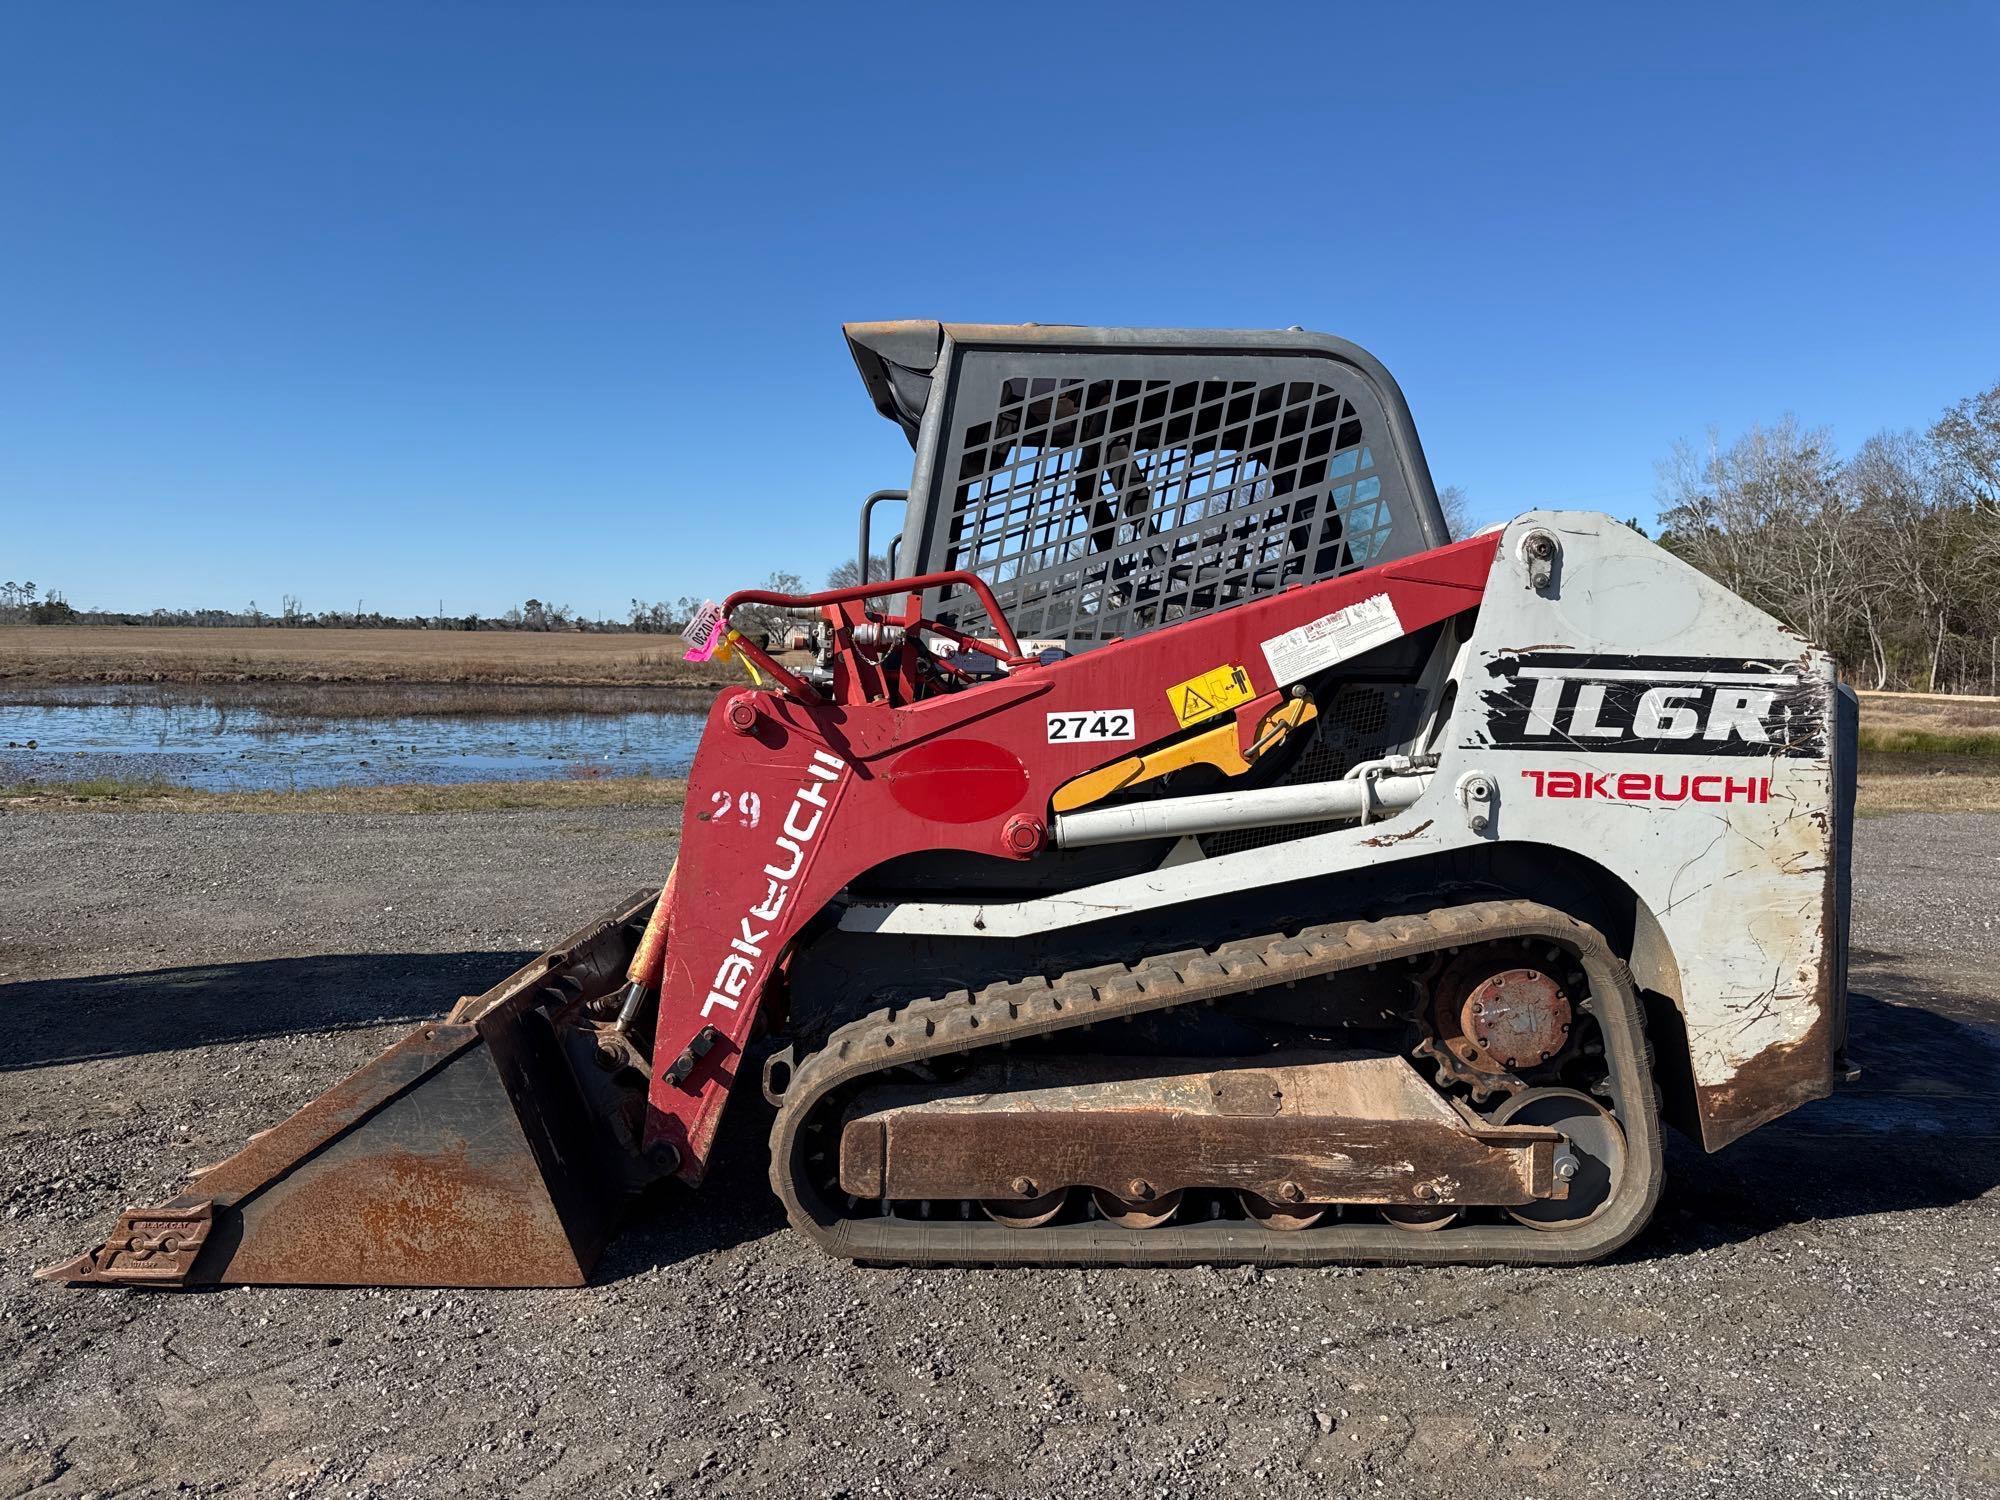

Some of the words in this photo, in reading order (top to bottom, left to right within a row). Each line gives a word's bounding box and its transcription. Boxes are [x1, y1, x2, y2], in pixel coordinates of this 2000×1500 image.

[1517, 667, 1798, 741] TL6R
[1048, 715, 1129, 740] 2742
[711, 790, 760, 828] 29
